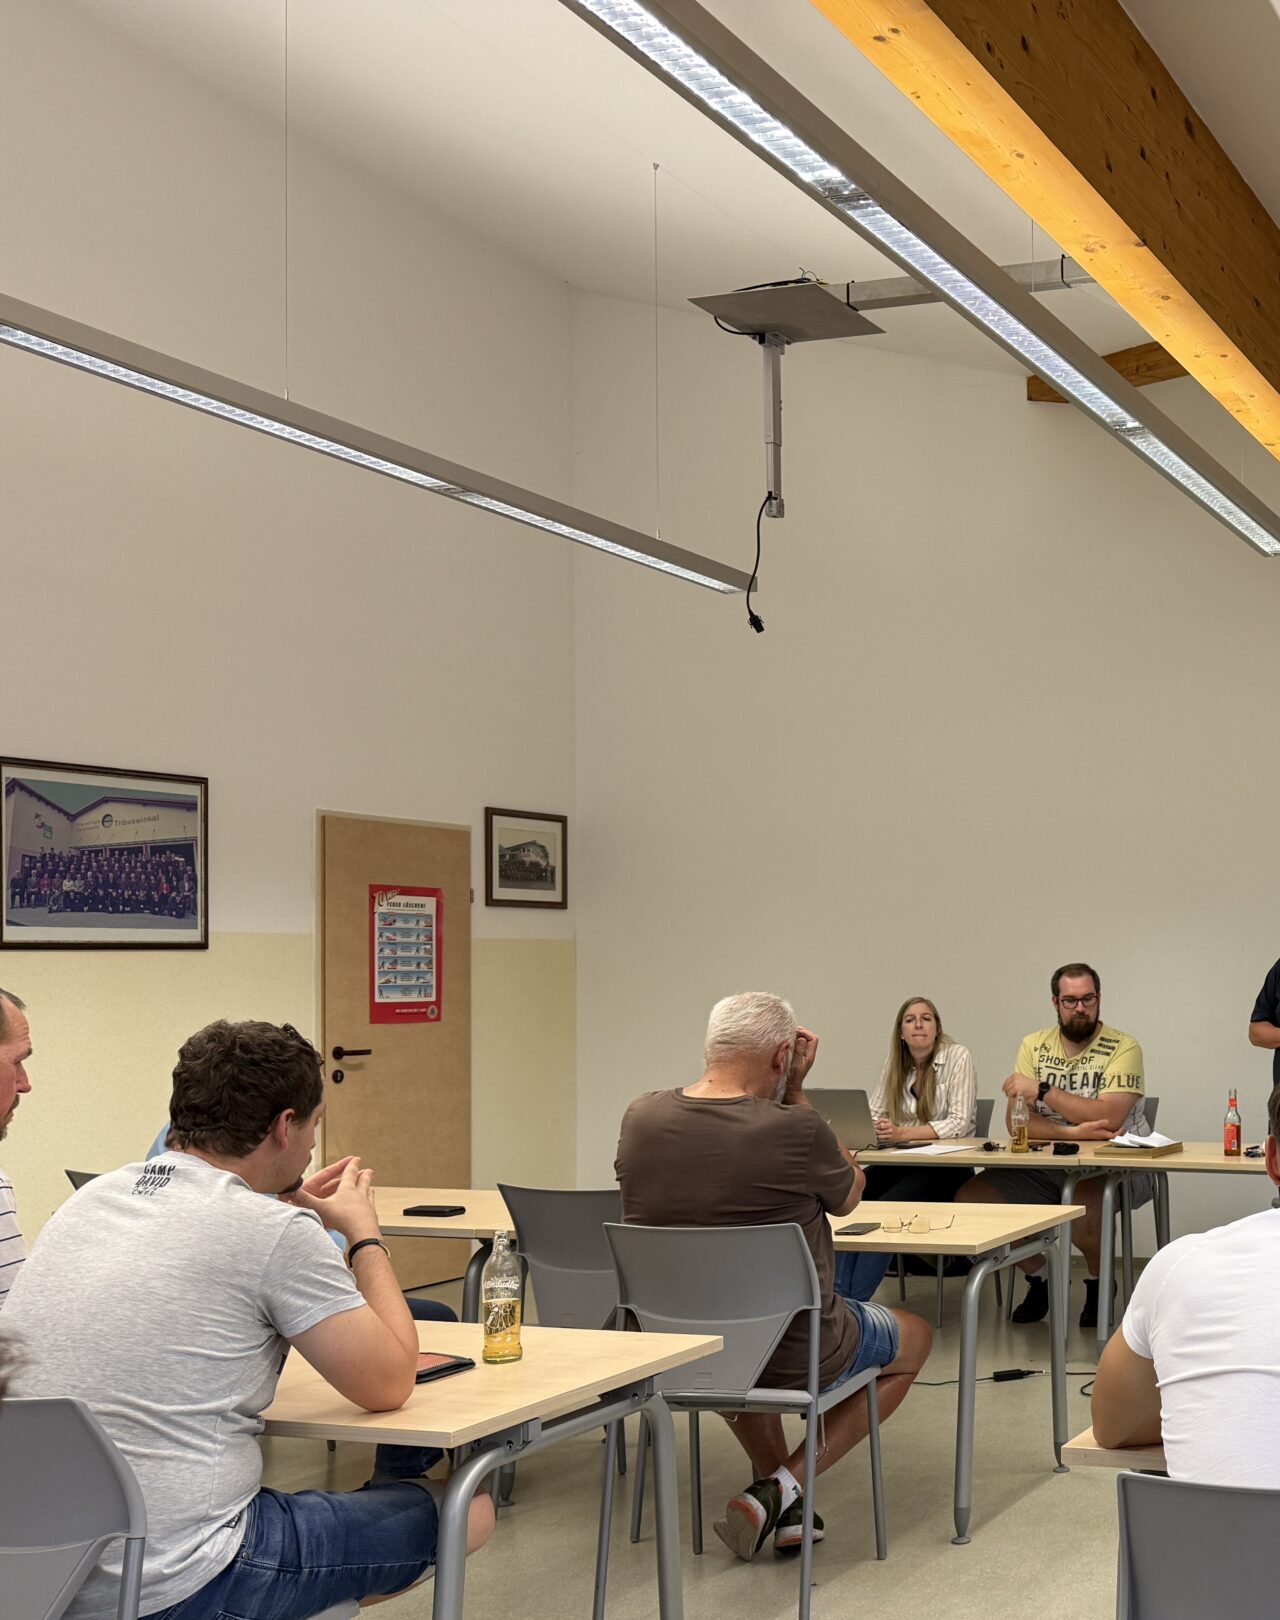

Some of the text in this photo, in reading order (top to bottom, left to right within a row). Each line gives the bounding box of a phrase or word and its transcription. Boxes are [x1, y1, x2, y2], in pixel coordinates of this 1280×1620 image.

[1081, 1056, 1095, 1065] OF
[1046, 1071, 1103, 1091] OCEAN
[143, 1163, 176, 1176] CAMP
[135, 1175, 171, 1188] DAVID
